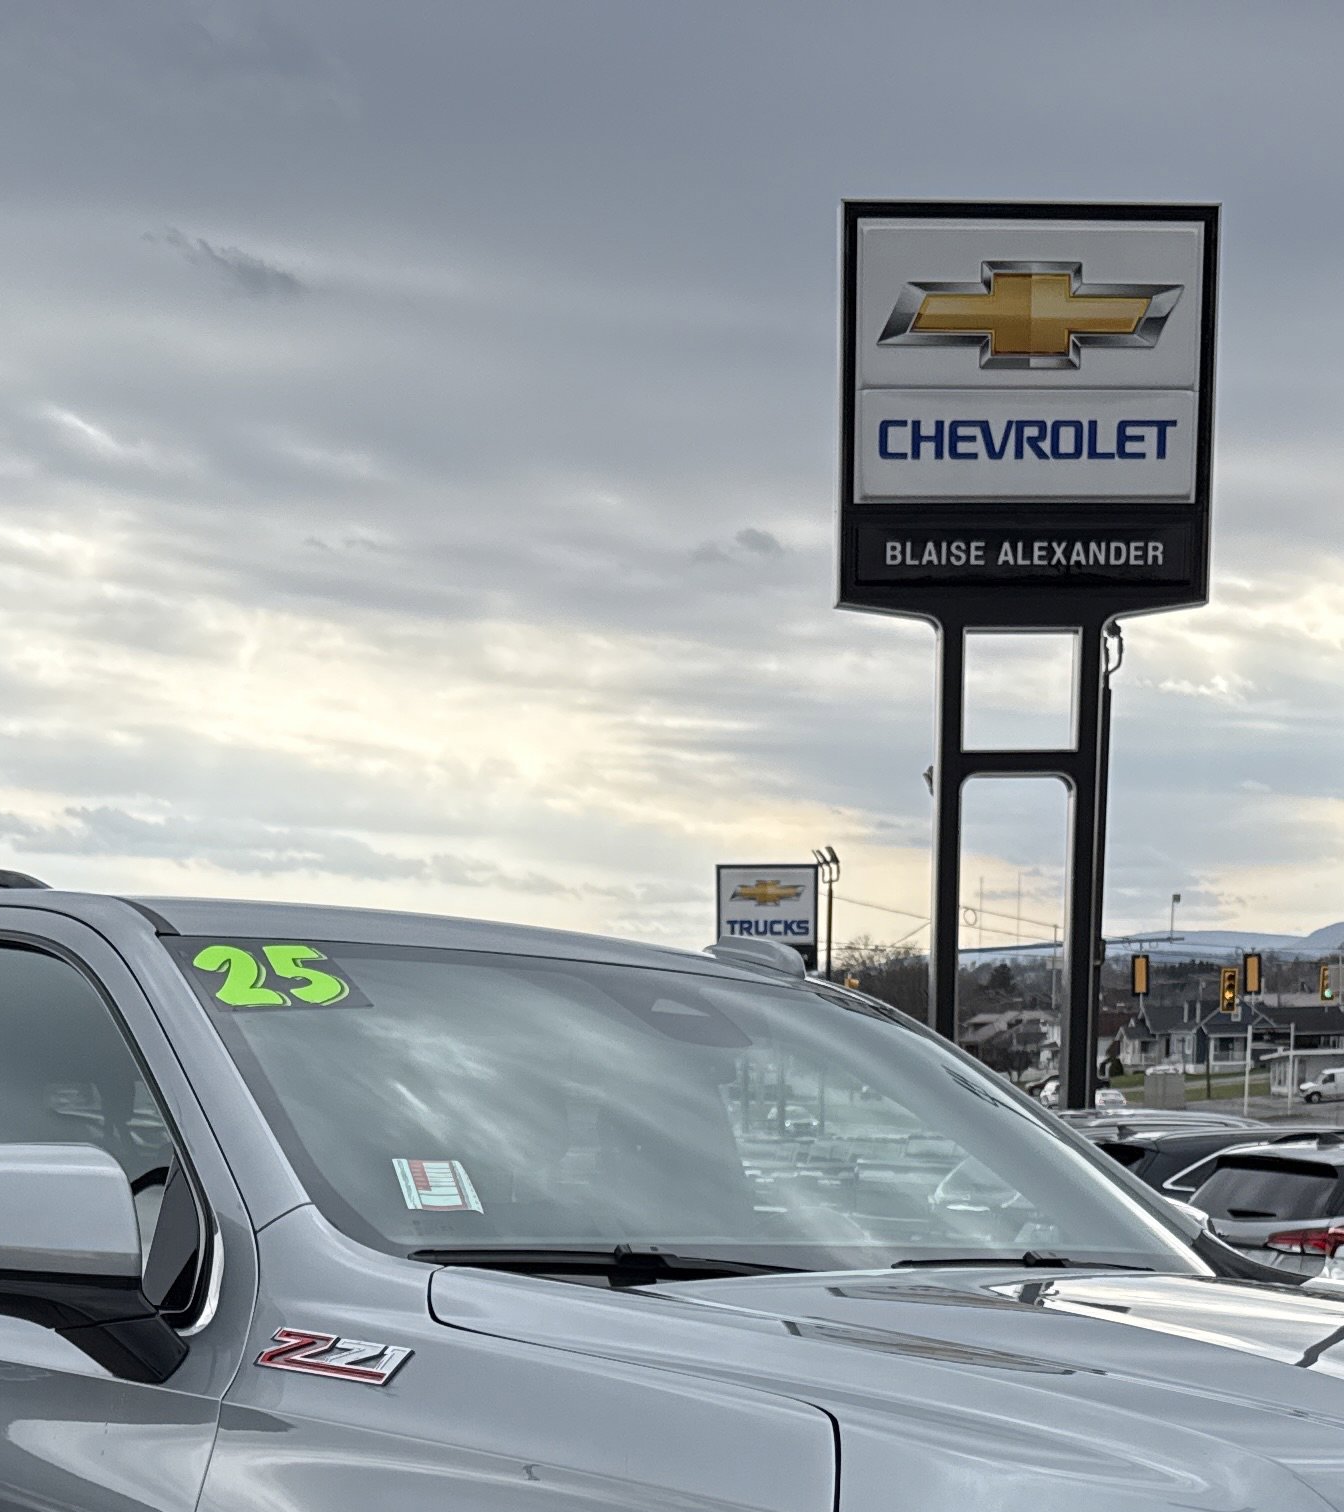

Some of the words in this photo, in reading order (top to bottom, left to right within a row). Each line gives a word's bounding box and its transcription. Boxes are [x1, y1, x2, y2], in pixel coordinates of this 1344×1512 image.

[878, 419, 1178, 460] CHEVROLET
[885, 541, 985, 566] BLAISE
[997, 542, 1164, 566] ALEXANDER
[726, 919, 810, 936] TRUCKS
[192, 945, 350, 1007] 25
[253, 1326, 416, 1386] Z71
